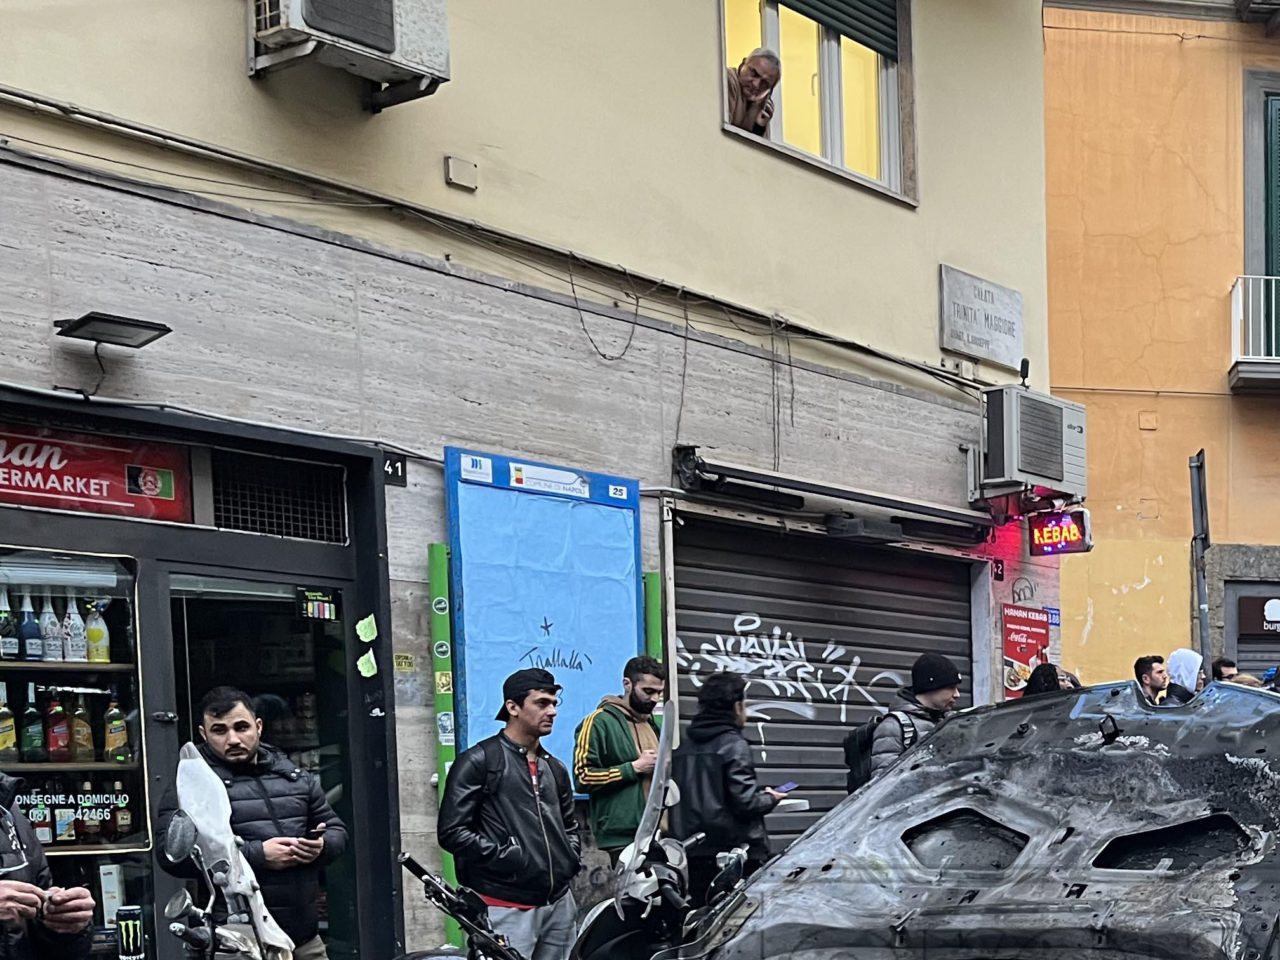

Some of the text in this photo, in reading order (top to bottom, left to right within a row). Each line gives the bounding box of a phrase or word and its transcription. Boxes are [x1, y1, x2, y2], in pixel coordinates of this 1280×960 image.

[984, 313, 1016, 338] MAGGIORE
[384, 459, 402, 476] 41
[0, 468, 110, 496] ERMARKET
[562, 486, 586, 496] NAPOLI
[612, 488, 624, 497] 25
[1033, 523, 1079, 545] KEBAB
[1028, 611, 1048, 622] KEBAB
[14, 794, 129, 805] ONSEGNE A DOMICILIO
